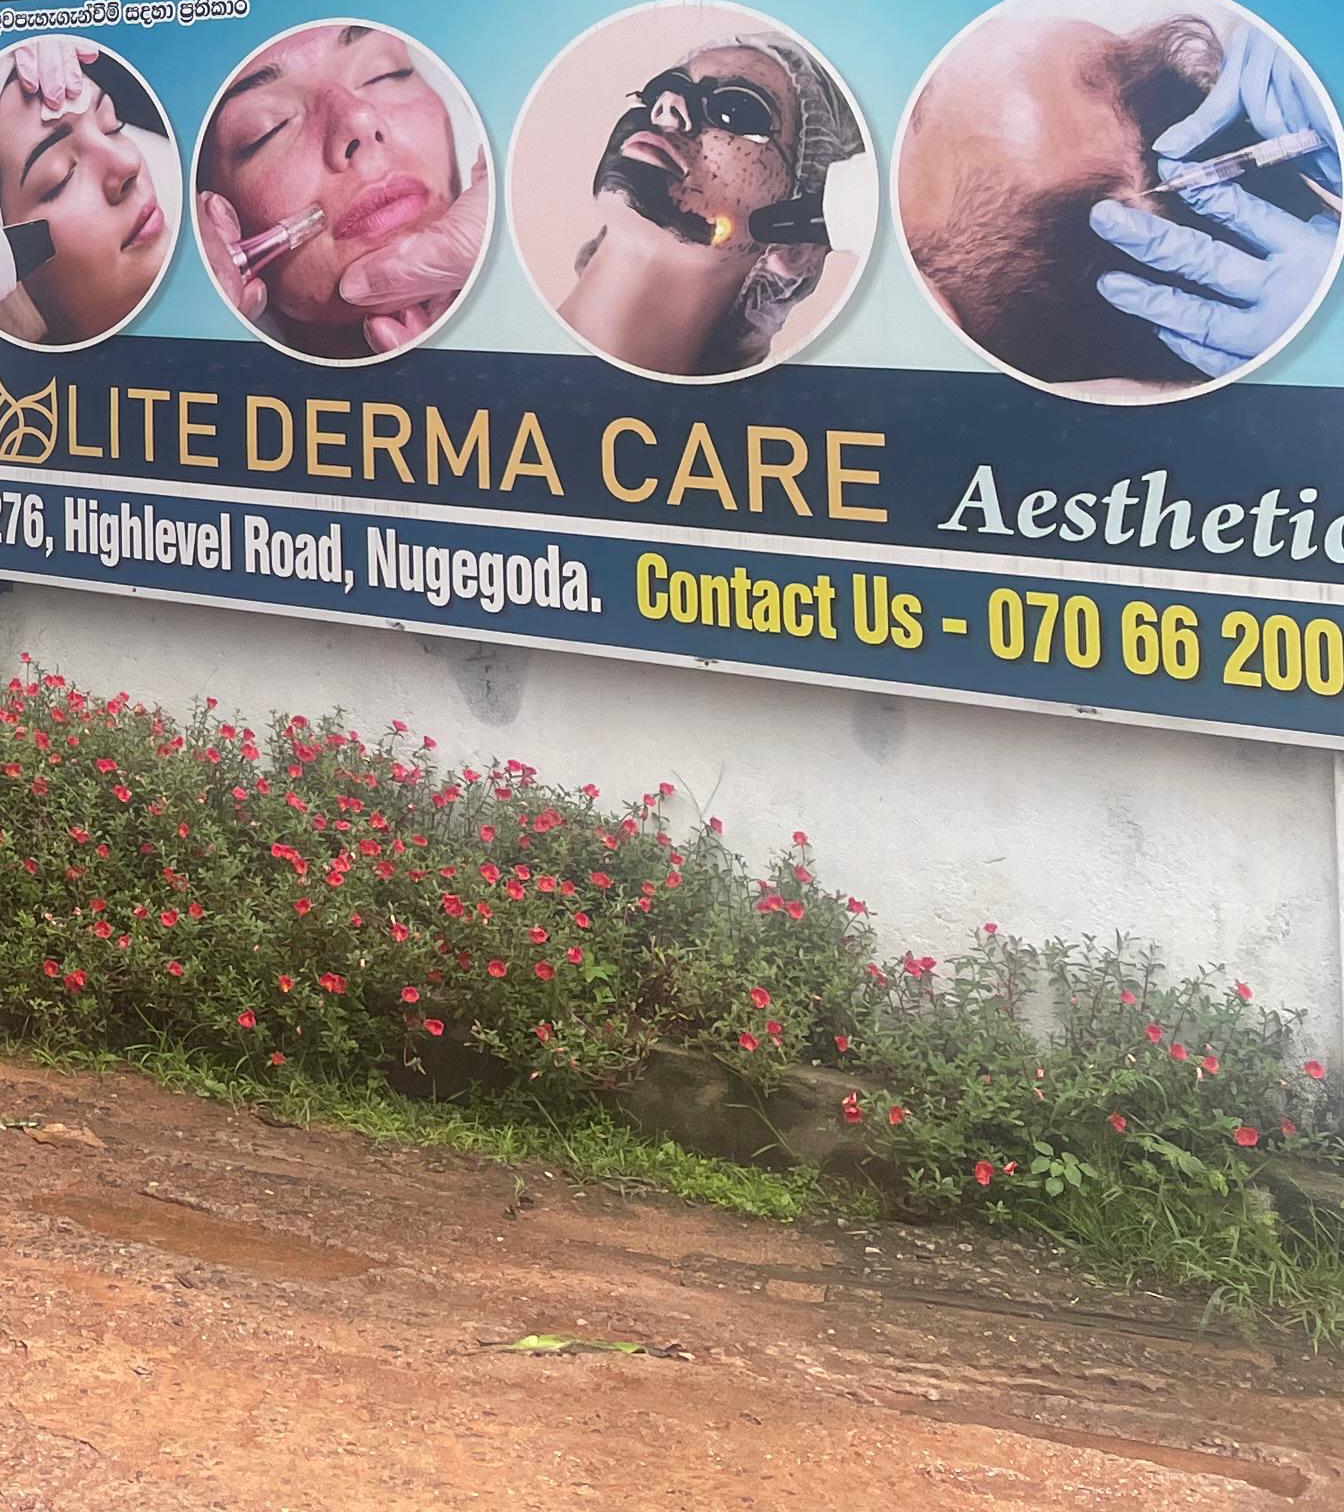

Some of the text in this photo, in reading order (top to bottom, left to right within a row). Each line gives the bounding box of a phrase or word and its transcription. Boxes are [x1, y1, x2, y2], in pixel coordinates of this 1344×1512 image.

[68, 383, 219, 468] LITE
[246, 395, 564, 497] DERMA
[600, 418, 888, 524] CARE
[65, 498, 231, 571] Highlevel
[246, 516, 354, 594] Road,
[367, 528, 603, 614] Nugegoda.
[637, 553, 837, 640] Contact
[853, 574, 923, 649] Us
[943, 618, 967, 636] -
[989, 589, 1101, 670] 070
[1124, 601, 1200, 680] 66
[1221, 610, 1344, 696] 200
